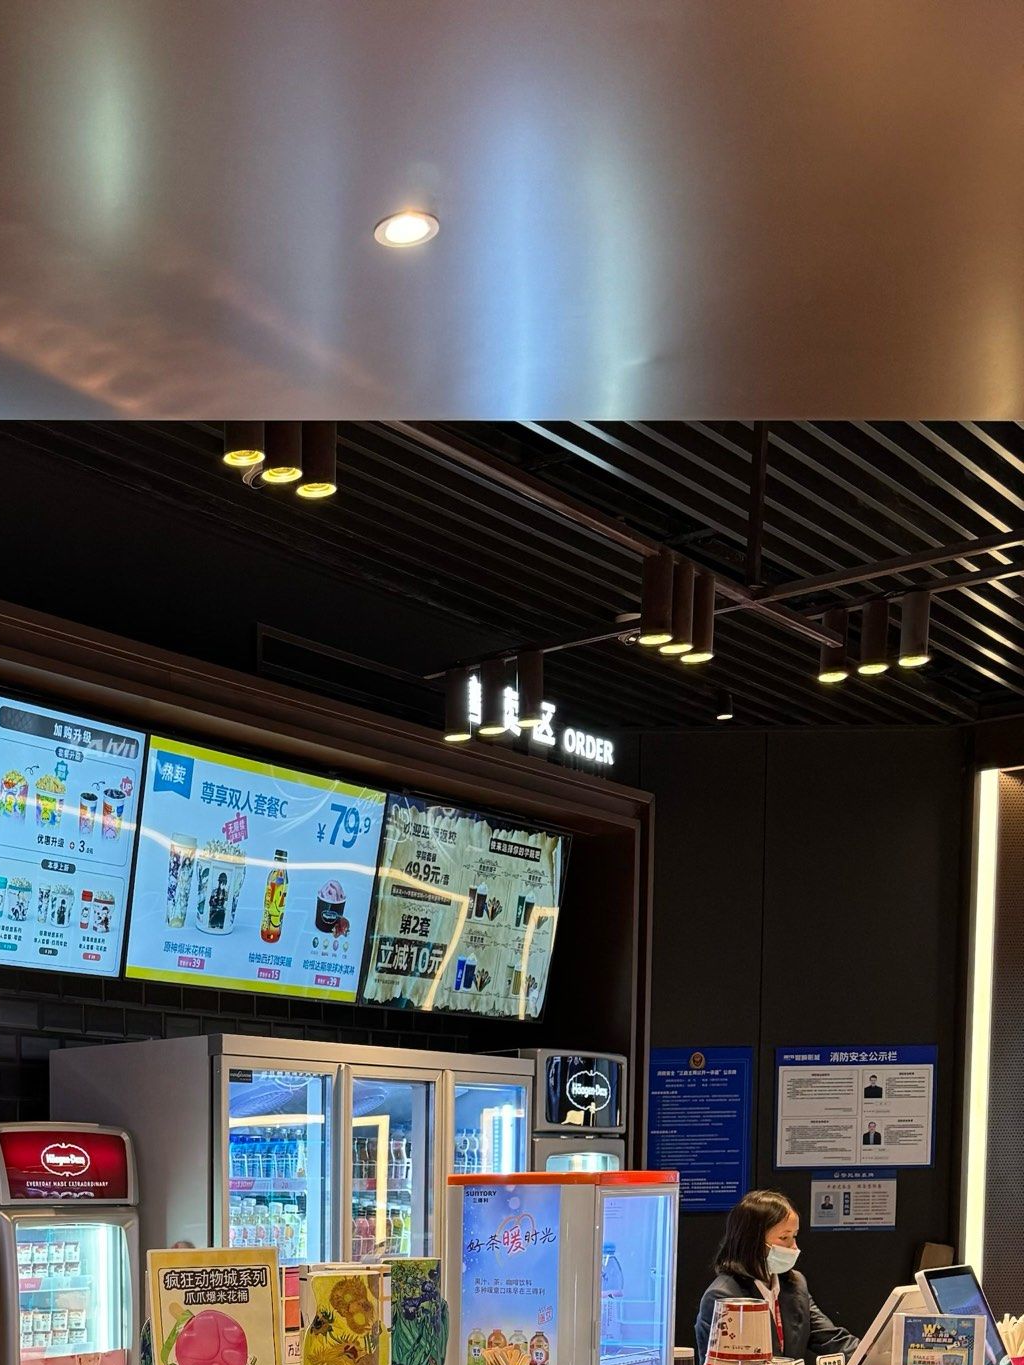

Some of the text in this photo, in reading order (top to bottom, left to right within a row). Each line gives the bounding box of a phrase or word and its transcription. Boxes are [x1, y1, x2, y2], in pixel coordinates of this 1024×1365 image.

[53, 722, 92, 744] 加购升级
[563, 728, 614, 765] ORDER
[160, 762, 187, 785] 热卖
[122, 781, 132, 791] UP
[201, 781, 289, 819] 尊享双人套餐C
[36, 834, 65, 849] 优惠升级
[78, 840, 85, 853] 3
[399, 914, 431, 937] 第2套
[377, 943, 444, 976] 立减10元
[829, 1051, 898, 1062] 消防安全公示栏
[571, 1082, 609, 1099] Häagen-Dazs
[466, 1225, 557, 1255] 好茶暖时光
[163, 1267, 268, 1291] 疯狂动物城系列
[184, 1289, 250, 1305] 爪爪爆米花桶
